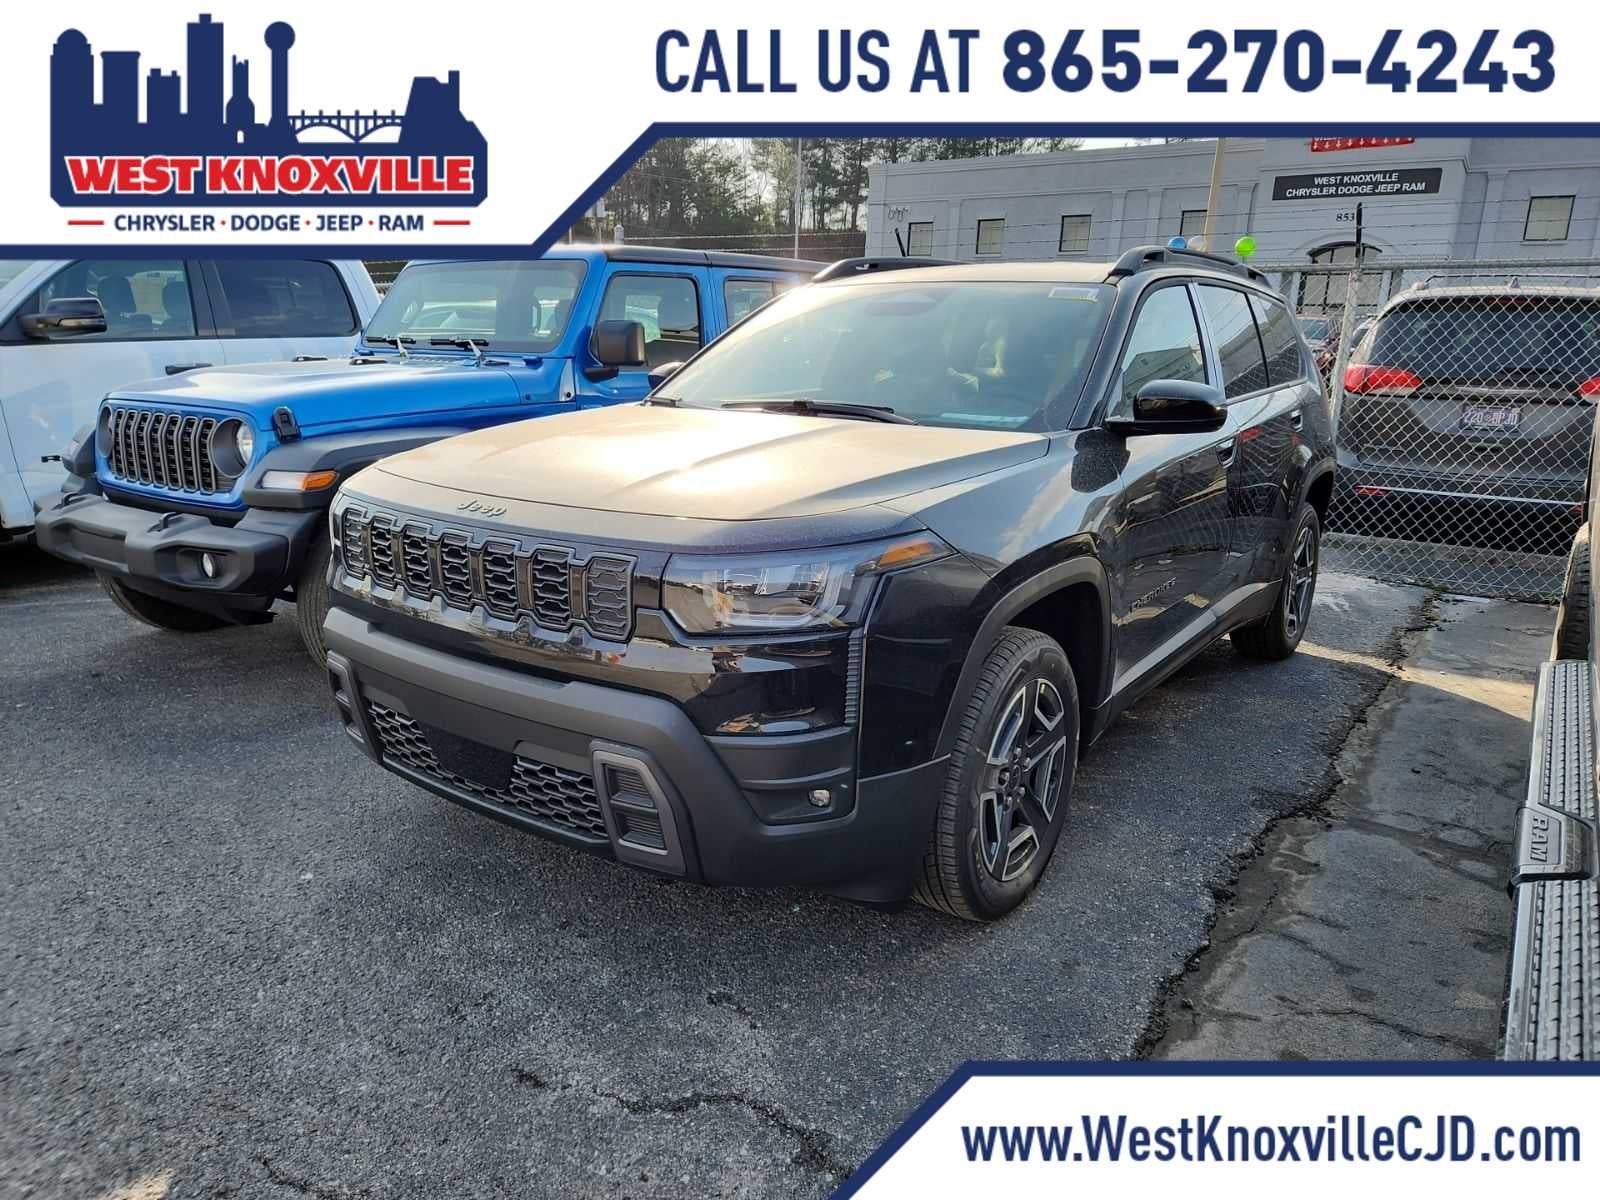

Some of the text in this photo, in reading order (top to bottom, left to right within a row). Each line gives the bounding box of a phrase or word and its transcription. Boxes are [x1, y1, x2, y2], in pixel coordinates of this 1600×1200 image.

[1314, 172, 1399, 185] WEST KNOXVILLE
[1286, 181, 1426, 197] CHRYSLER DODGE JEEP RAM
[457, 499, 508, 518] Jeep
[1529, 816, 1550, 863] RAM
